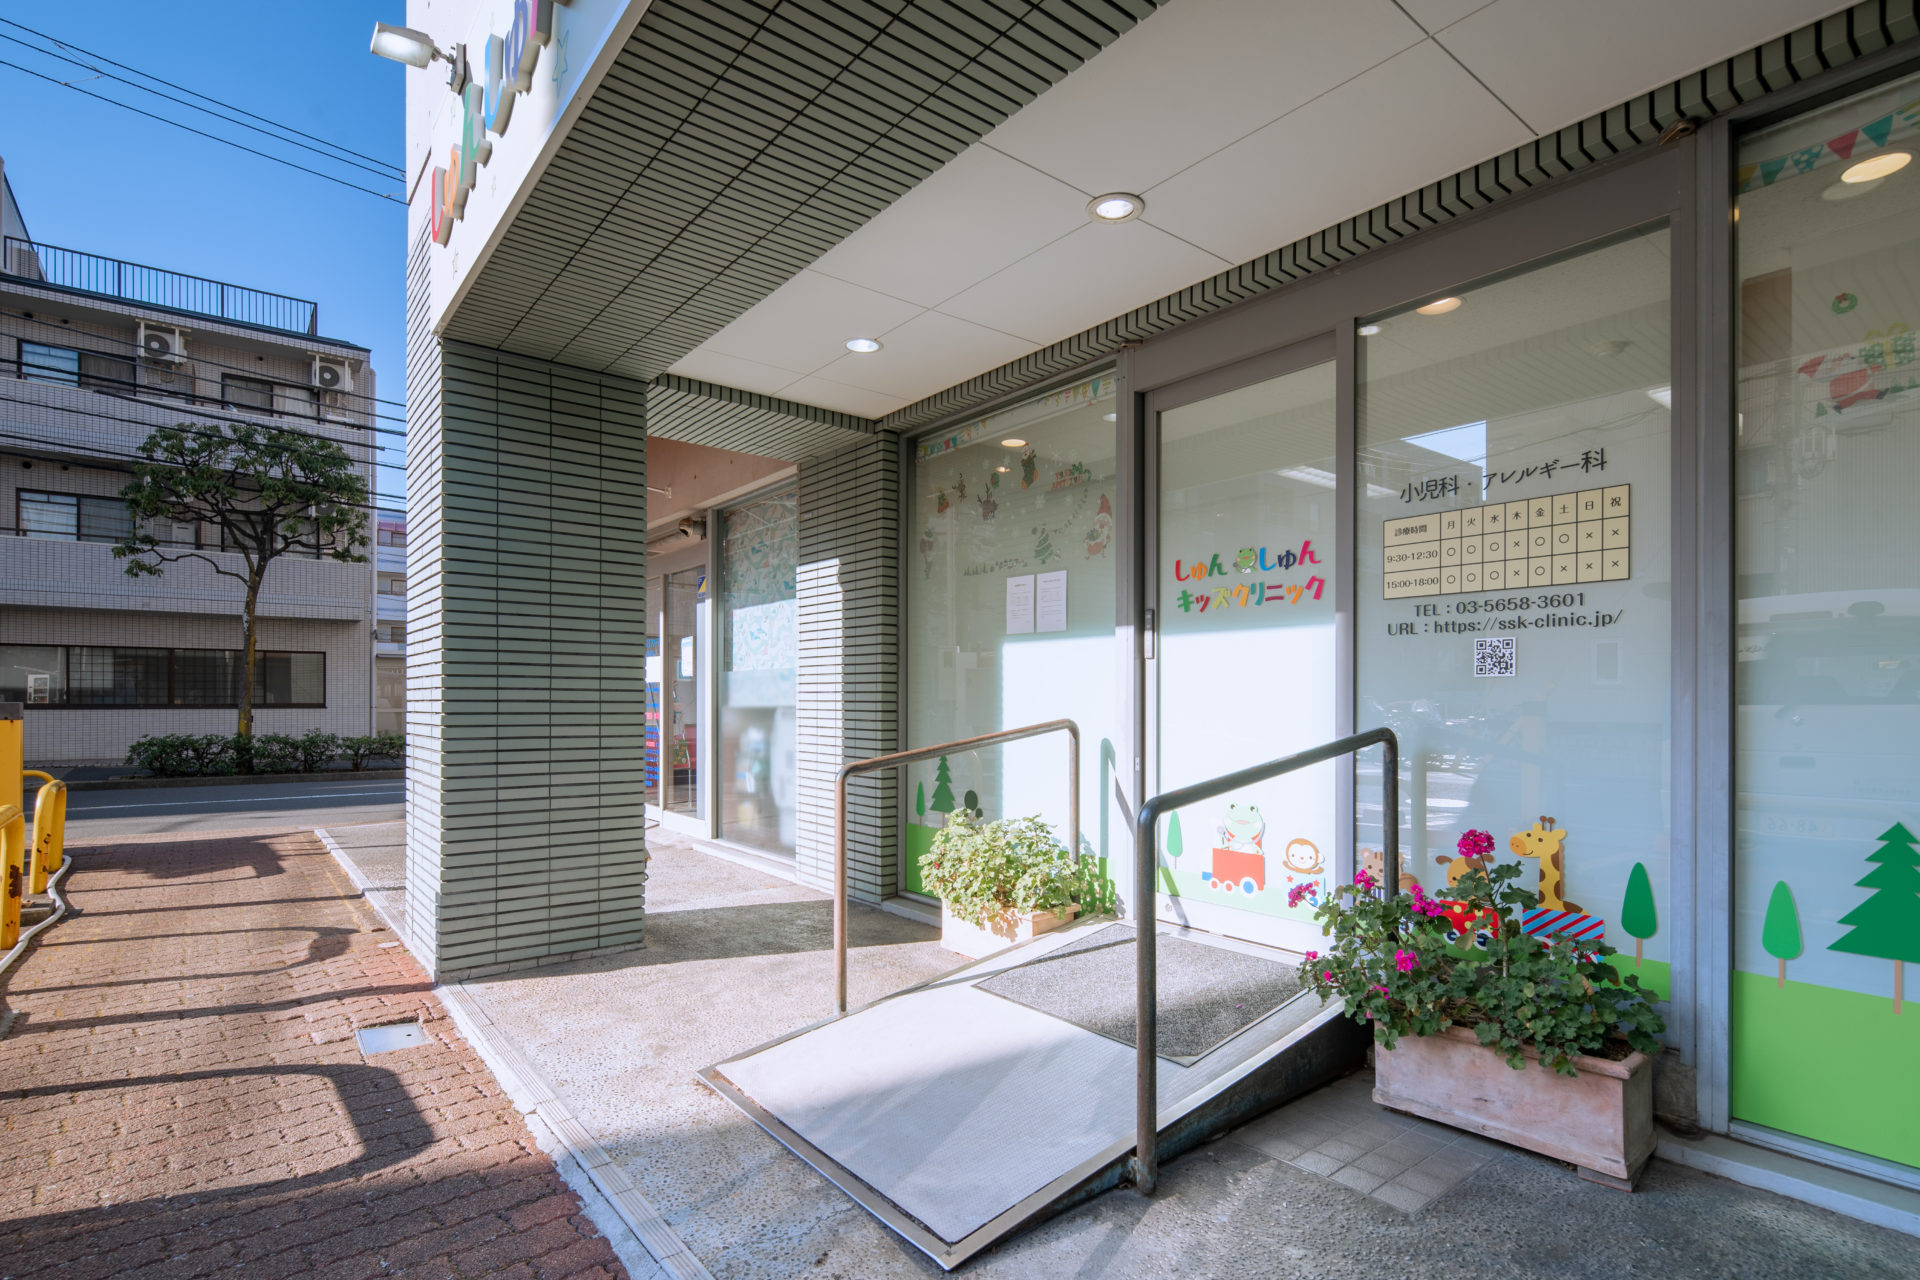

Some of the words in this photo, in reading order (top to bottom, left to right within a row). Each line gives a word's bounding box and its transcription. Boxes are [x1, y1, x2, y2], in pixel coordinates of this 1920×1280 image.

[1394, 524, 1428, 537] 診療時間
[1447, 521, 1456, 529] 月
[1466, 517, 1477, 527] 火
[1489, 514, 1500, 524] 水
[1511, 511, 1522, 520] 木
[1535, 507, 1545, 517] 金
[1559, 504, 1569, 514] 土
[1585, 501, 1594, 510] 日
[1610, 496, 1622, 507] 祝
[1386, 550, 1438, 563] 9:30-12:30
[1177, 575, 1325, 613] キッズクリニック
[1386, 577, 1439, 590] 15:00-18:00
[1456, 592, 1586, 615] 03-5658-3601
[1433, 609, 1624, 635] https://ssk-clinic.jp/
